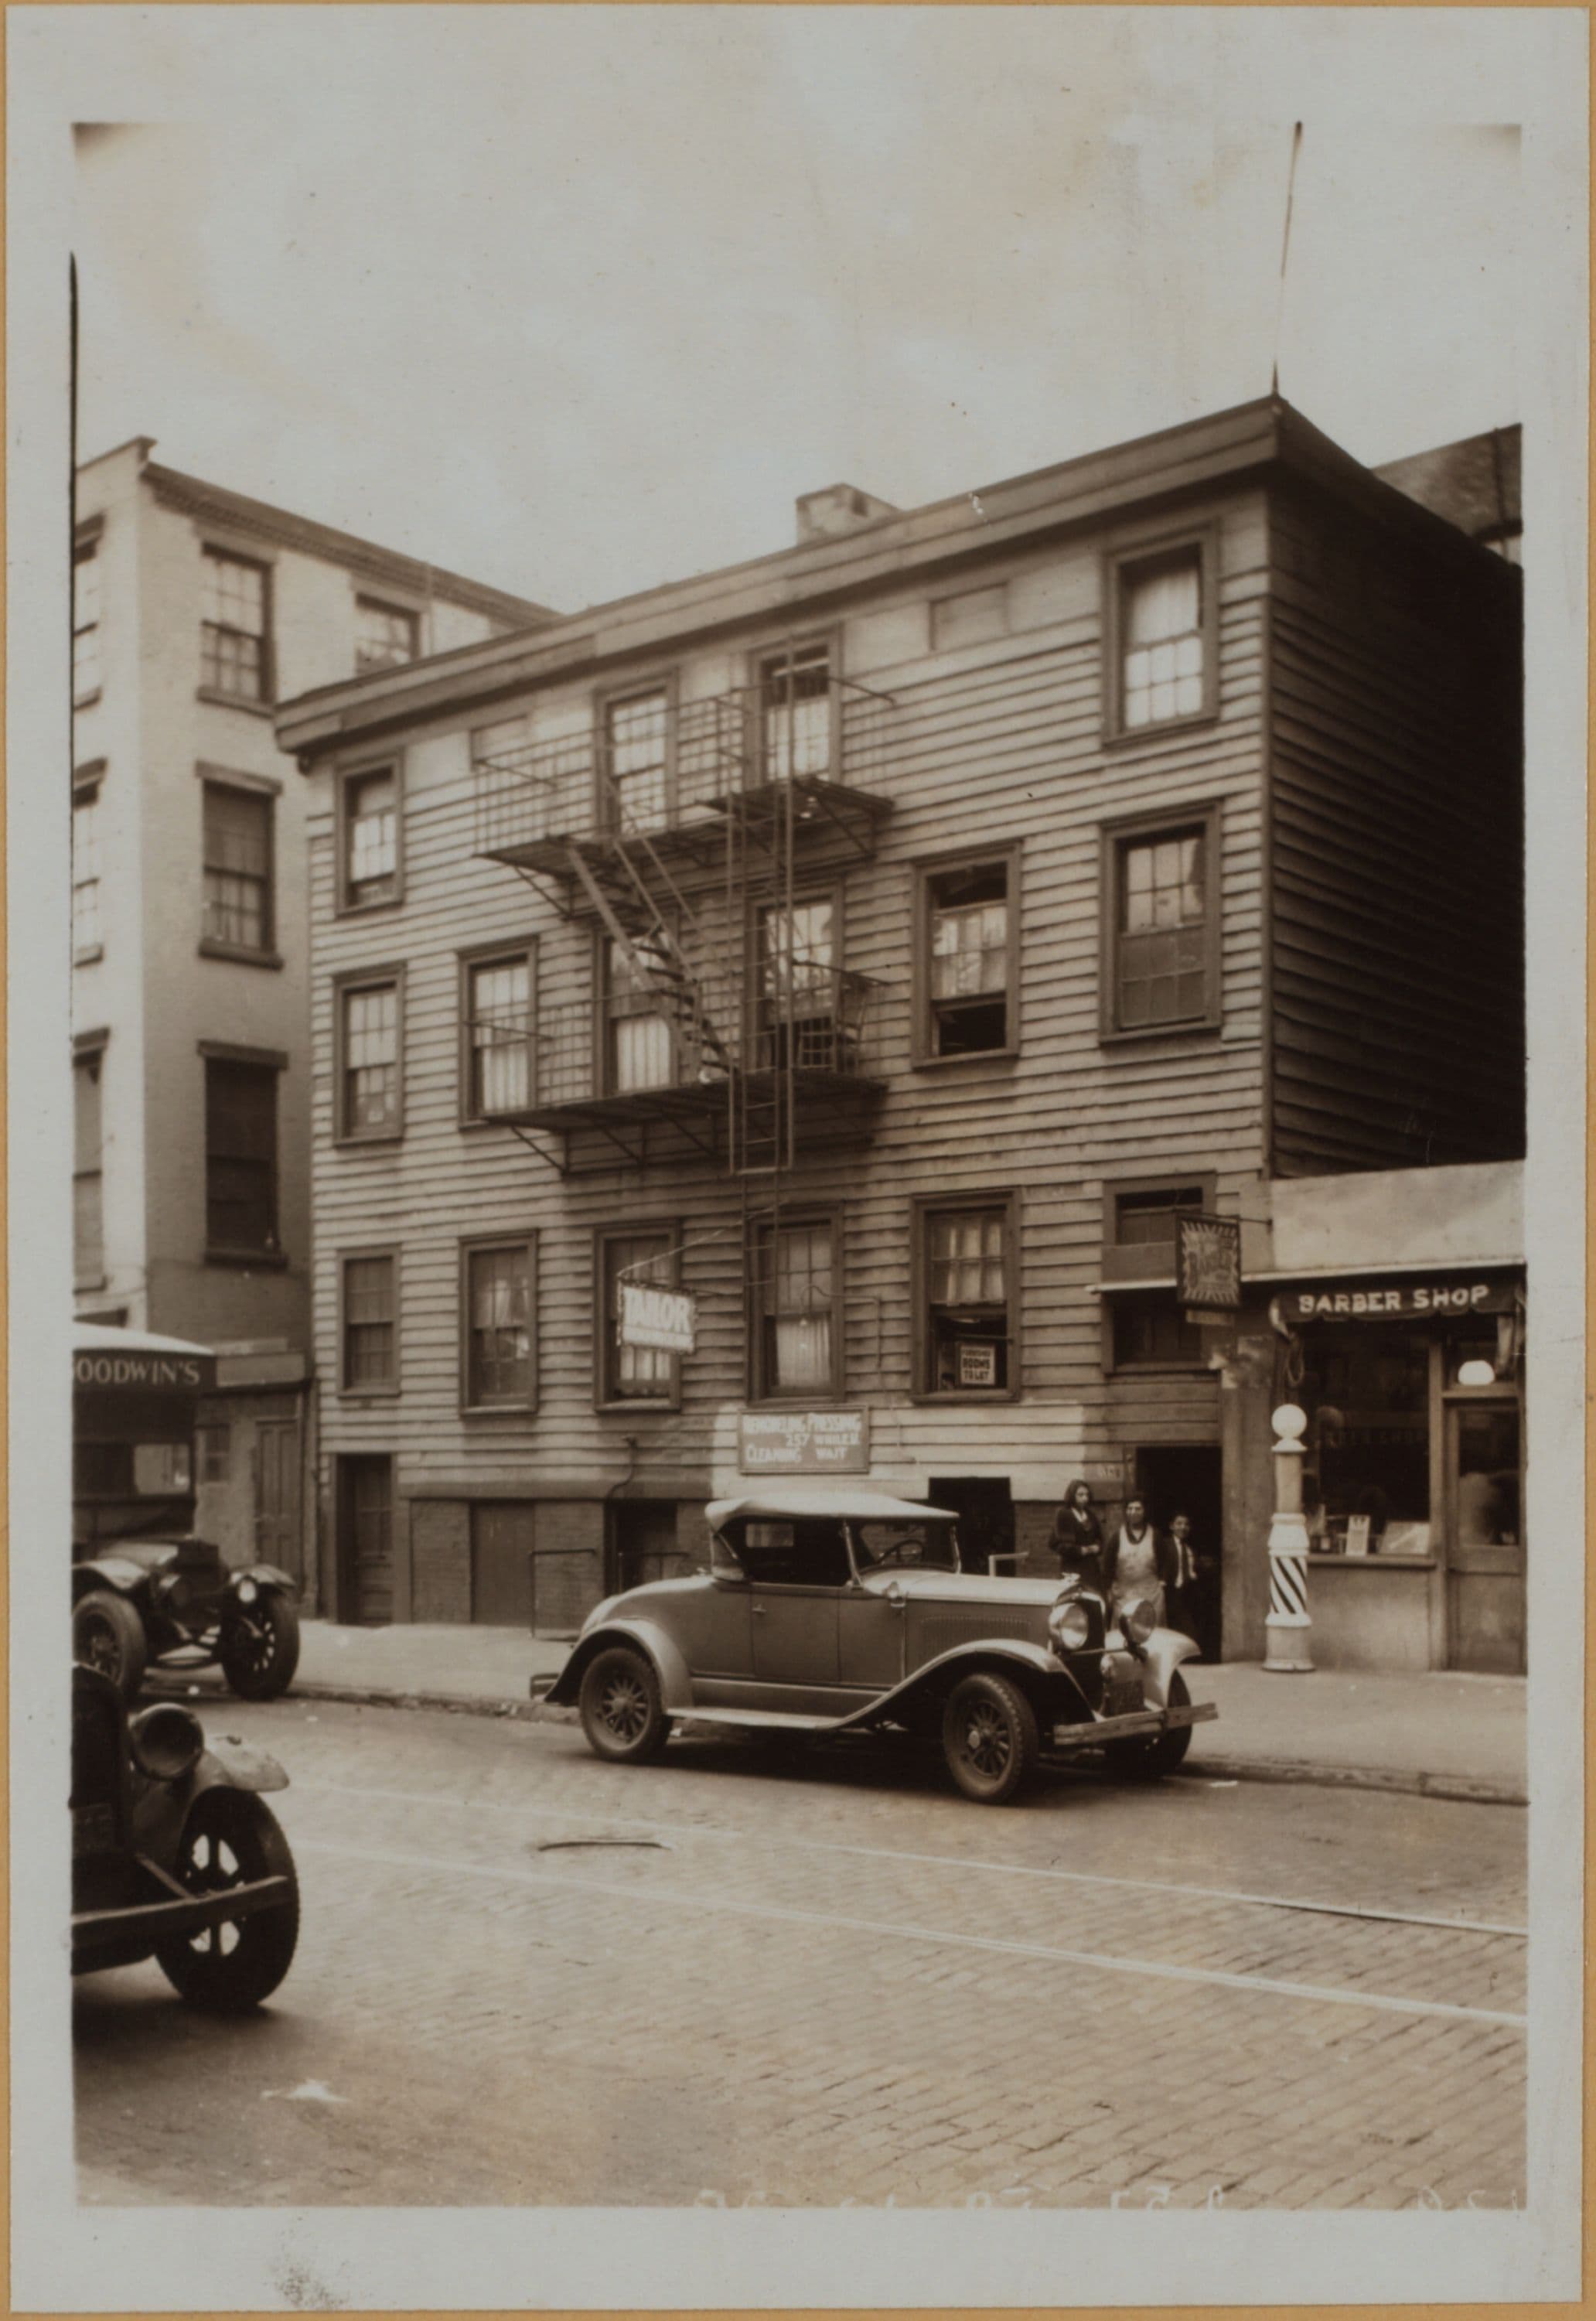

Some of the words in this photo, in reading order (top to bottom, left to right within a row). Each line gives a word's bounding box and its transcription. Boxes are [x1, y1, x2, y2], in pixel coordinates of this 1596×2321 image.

[622, 1287, 691, 1333] TAILOR
[1299, 1292, 1401, 1313] BARBER
[1413, 1285, 1489, 1307] SHOP
[73, 1357, 200, 1385] OODWIN'S
[962, 1357, 991, 1370] ROOMS
[963, 1369, 974, 1380] TO
[974, 1370, 990, 1381] LET
[745, 1443, 803, 1463] CLEANING
[815, 1447, 849, 1460] WAIT
